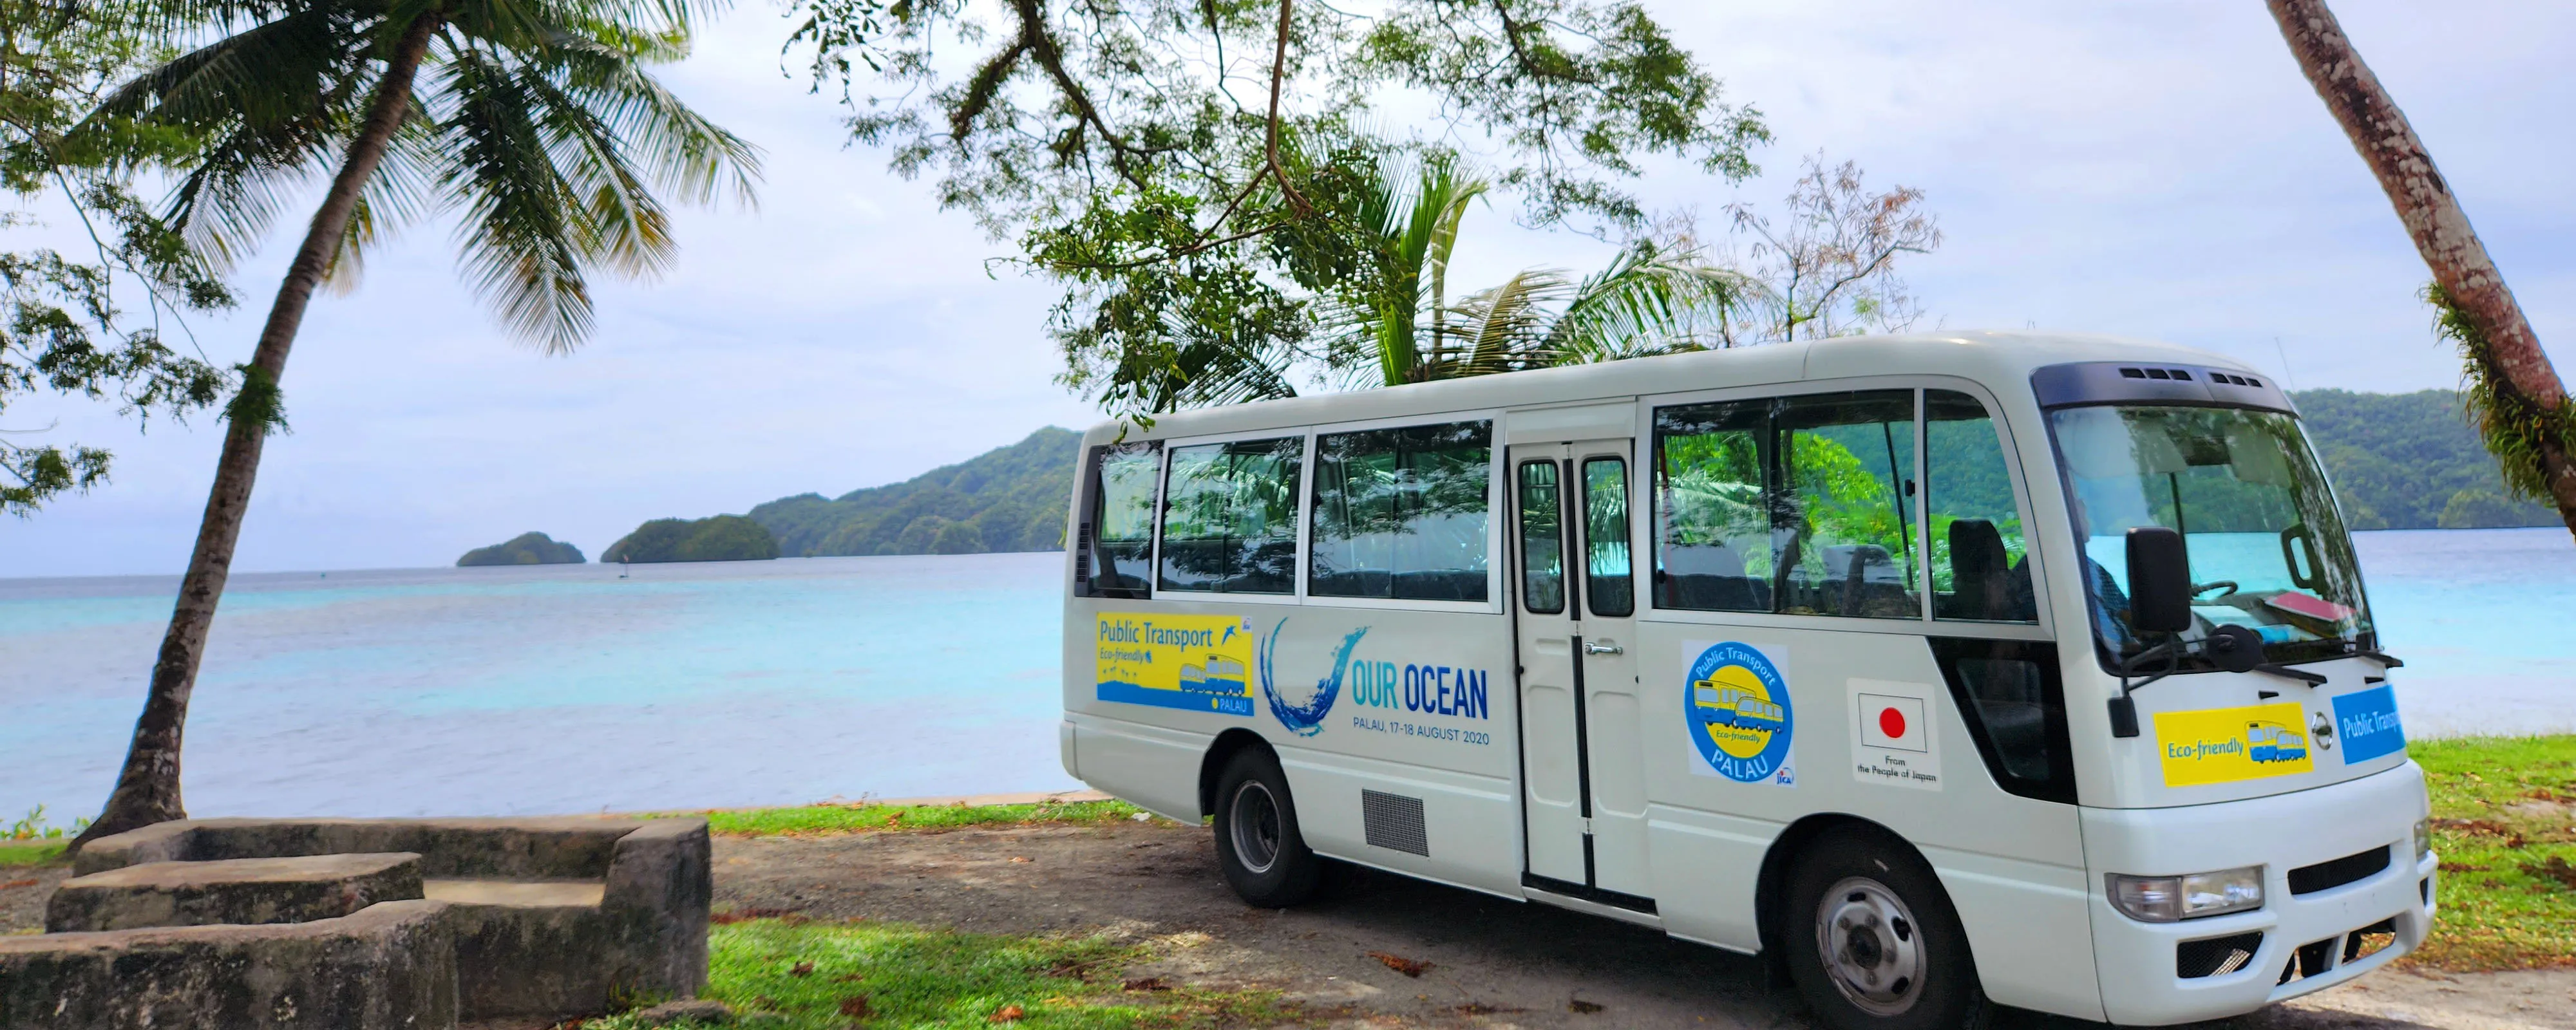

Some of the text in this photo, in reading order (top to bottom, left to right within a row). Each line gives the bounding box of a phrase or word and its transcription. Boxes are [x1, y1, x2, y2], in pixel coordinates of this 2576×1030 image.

[1100, 620, 1213, 652] Public Transport
[1099, 646, 1144, 664] Eco-friendly
[1696, 647, 1776, 686] Public Transport
[1352, 659, 1488, 720] OUR OCEAN
[1220, 698, 1247, 713] PALAU
[1353, 716, 1489, 745] PALAU, 17-18 AUGUST 2020
[1716, 730, 1761, 744] Eco-friendly
[2343, 713, 2374, 739] Public
[2168, 737, 2244, 760] Eco-friendly
[1711, 749, 1768, 779] PALAU
[1857, 763, 1937, 782] the People of Japan
[1885, 755, 1906, 767] From
